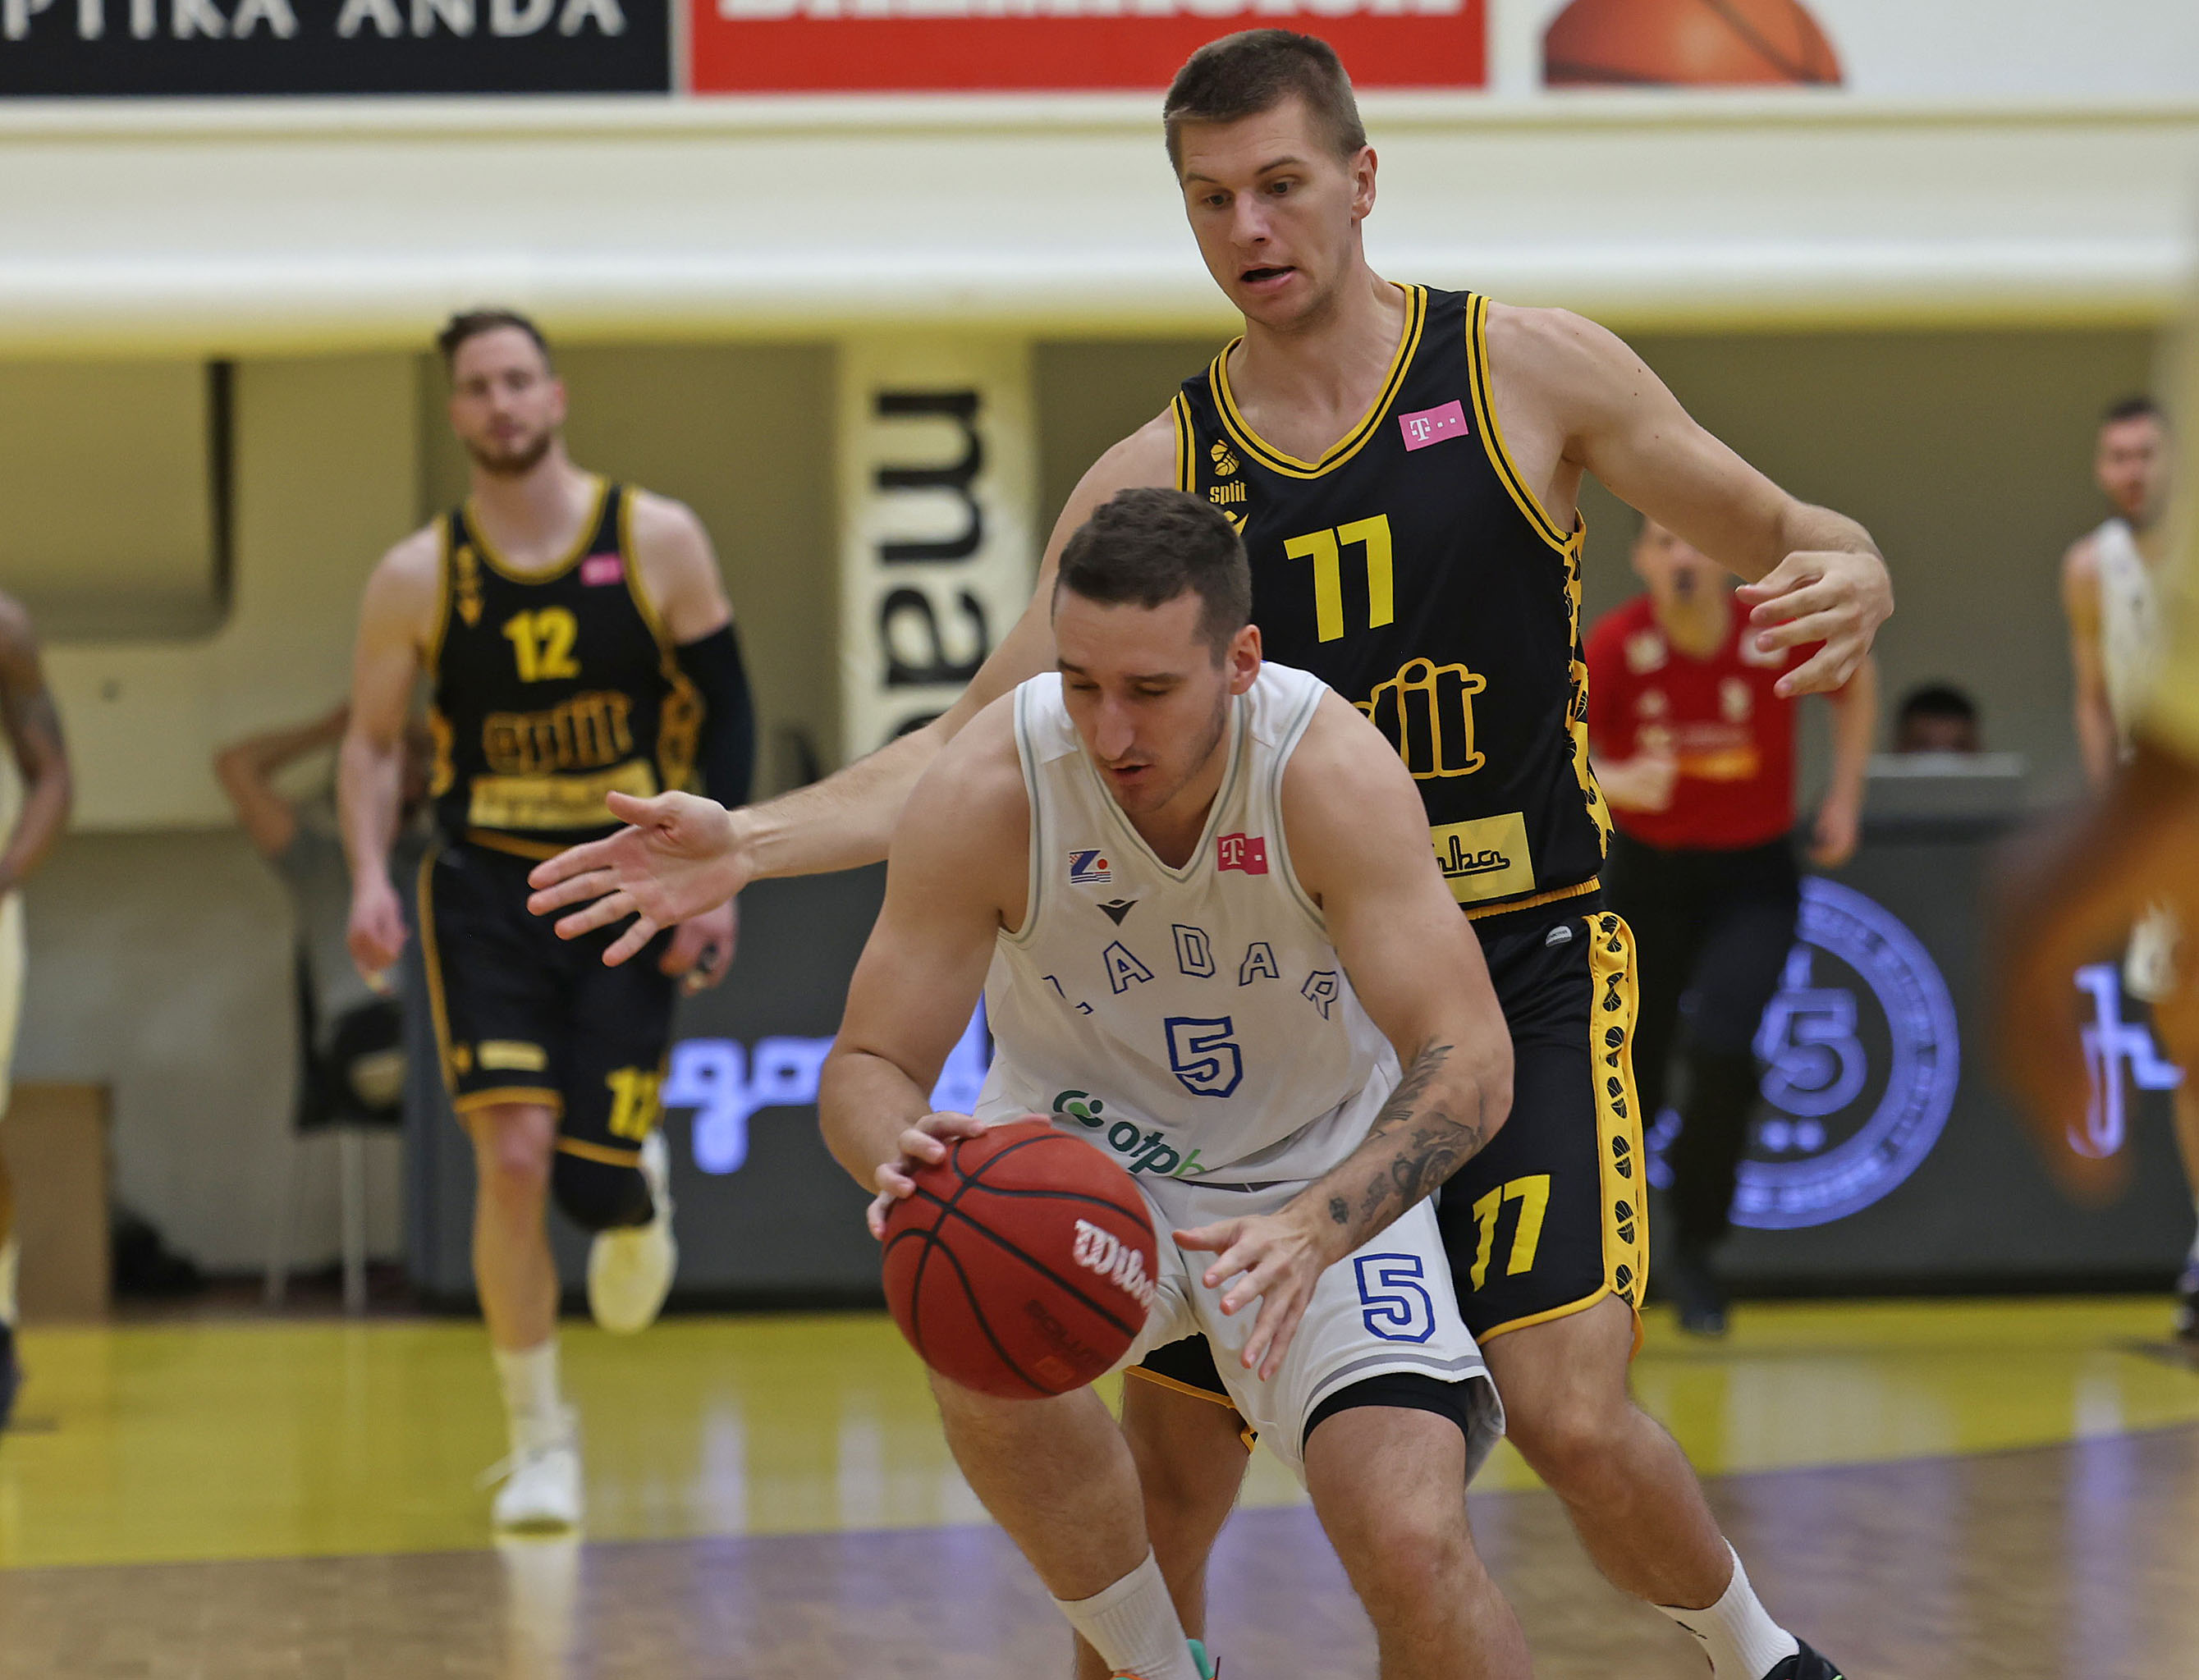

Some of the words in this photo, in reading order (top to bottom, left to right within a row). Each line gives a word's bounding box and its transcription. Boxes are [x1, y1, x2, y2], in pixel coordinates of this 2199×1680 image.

[1210, 479, 1248, 505] split
[1283, 513, 1394, 643] 77
[501, 607, 581, 683] 12
[1164, 1016, 1244, 1098] 5
[1353, 1252, 1436, 1344] 5
